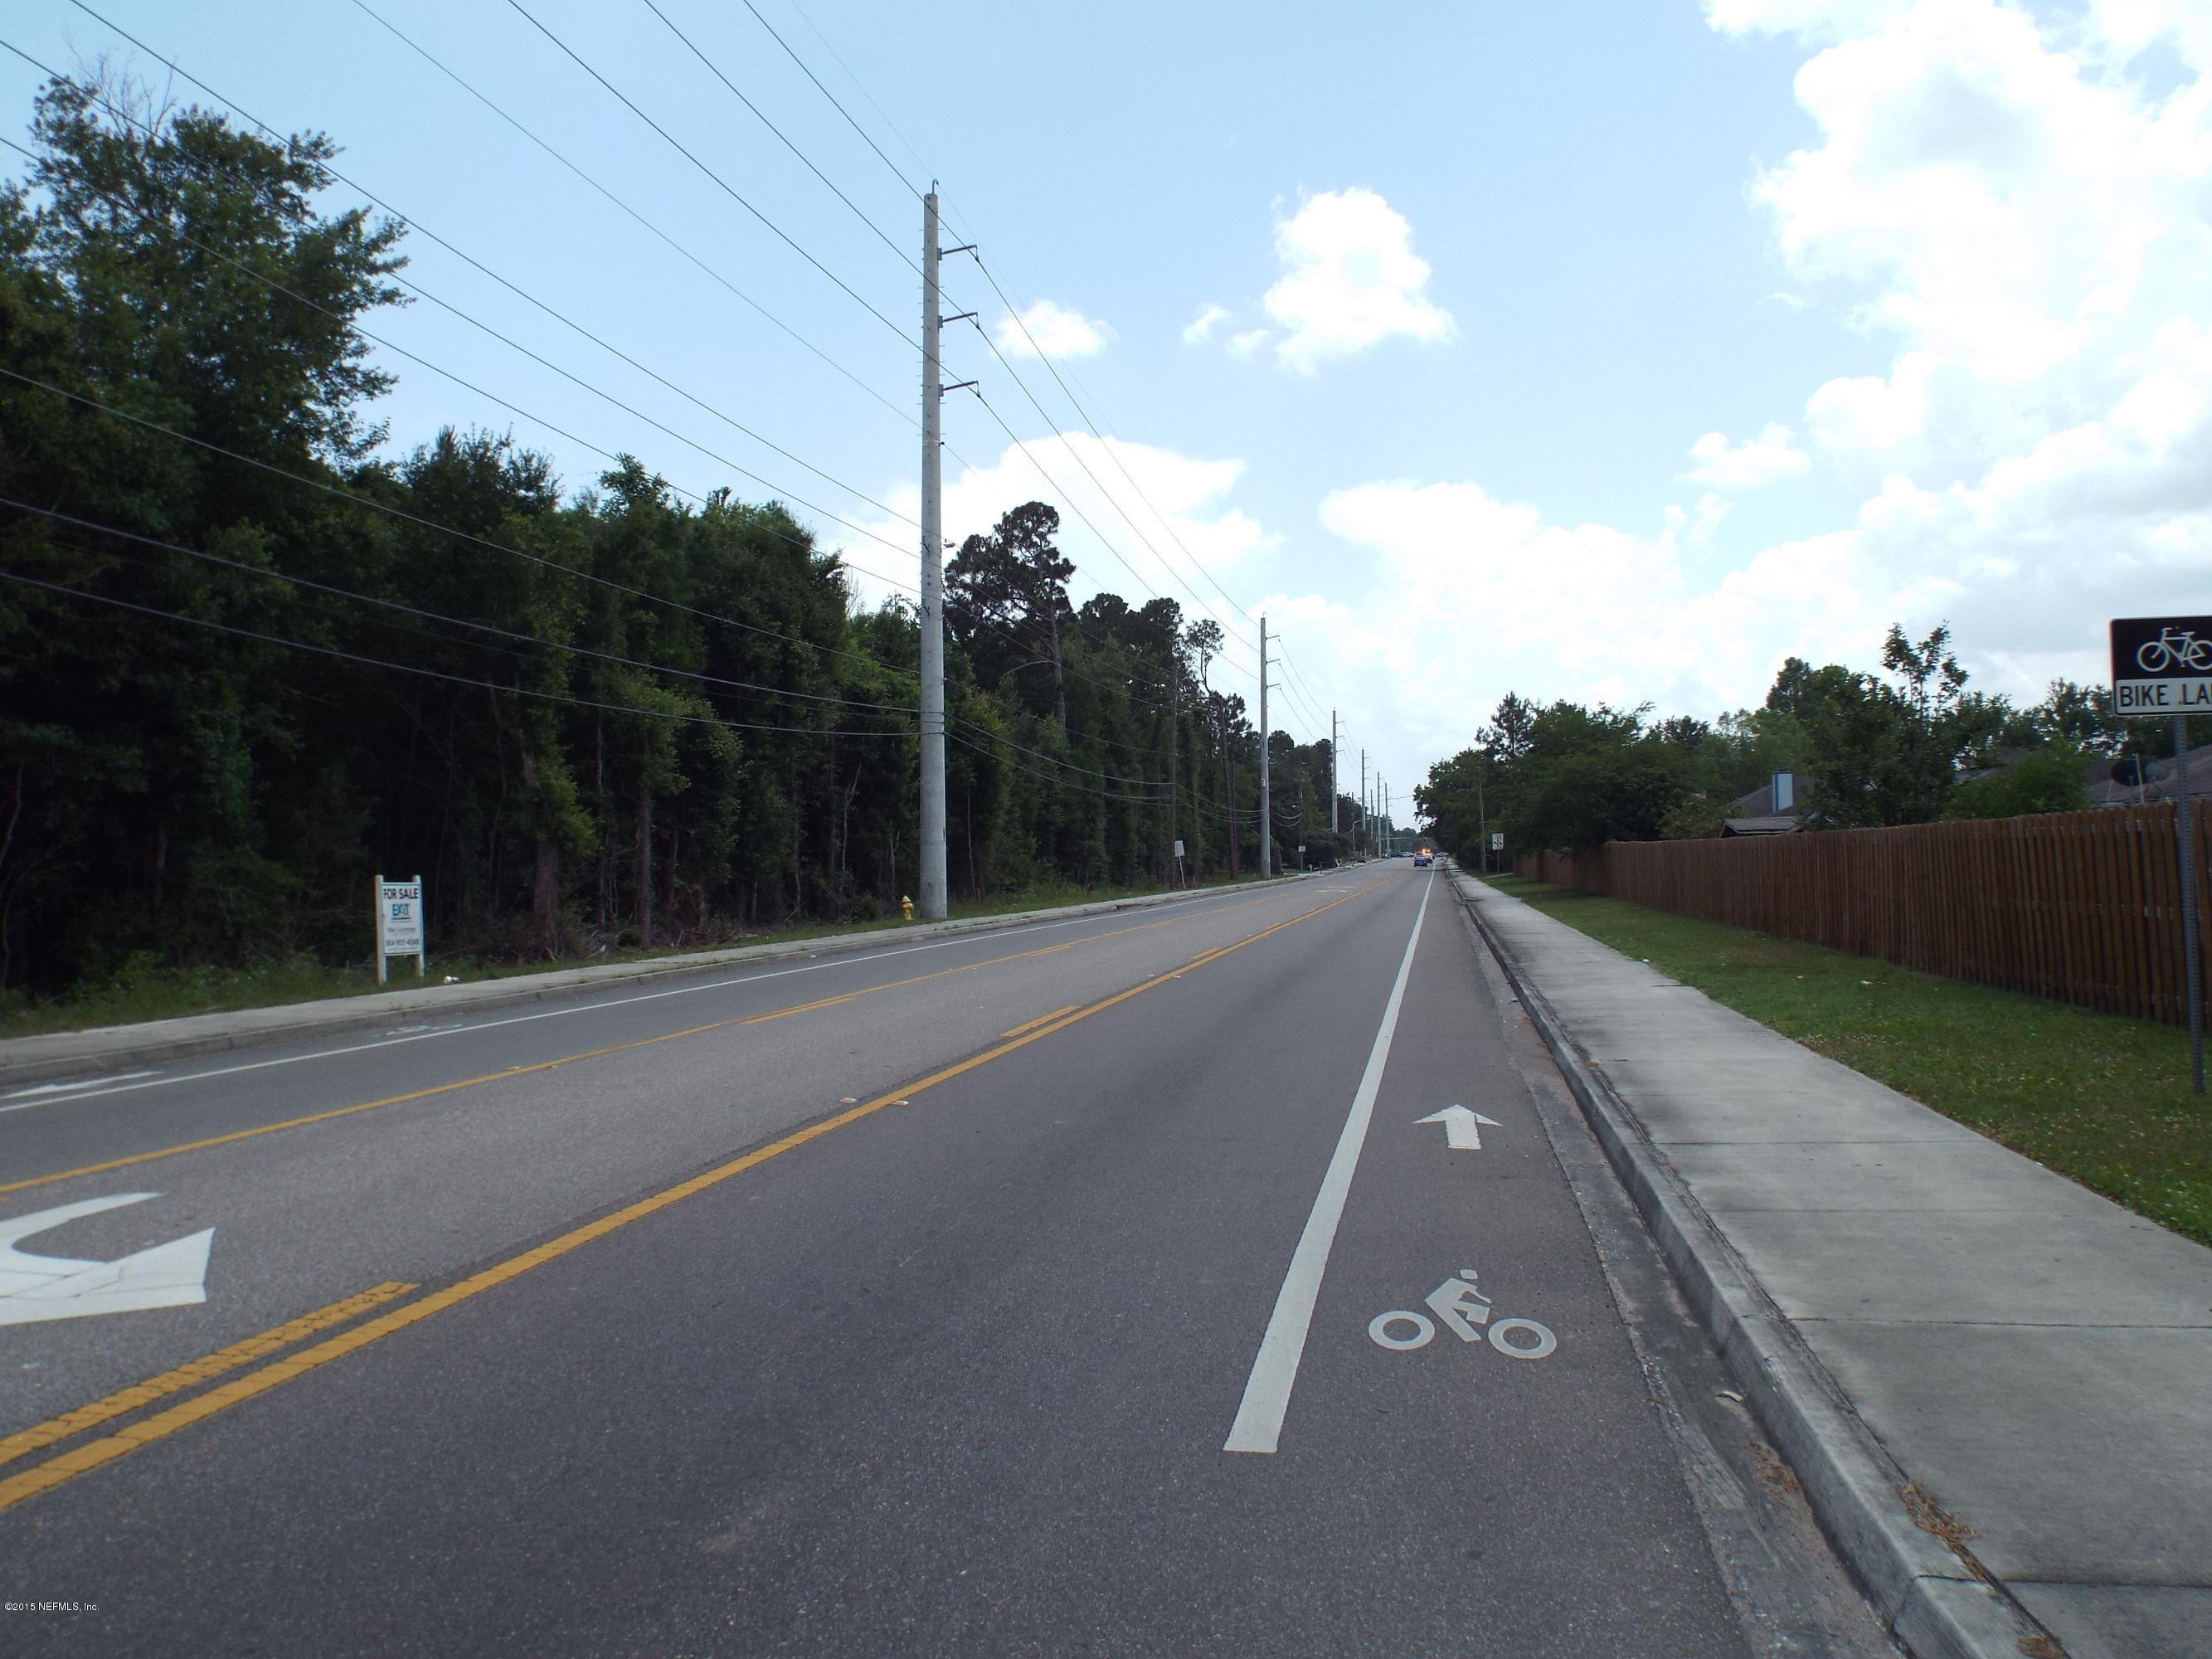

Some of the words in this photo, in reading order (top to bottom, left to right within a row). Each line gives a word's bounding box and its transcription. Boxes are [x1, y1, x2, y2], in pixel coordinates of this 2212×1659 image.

[2119, 684, 2170, 708] BIKE
[2181, 683, 2212, 706] LA
[383, 888, 397, 900] FOR
[399, 888, 419, 899] SALE
